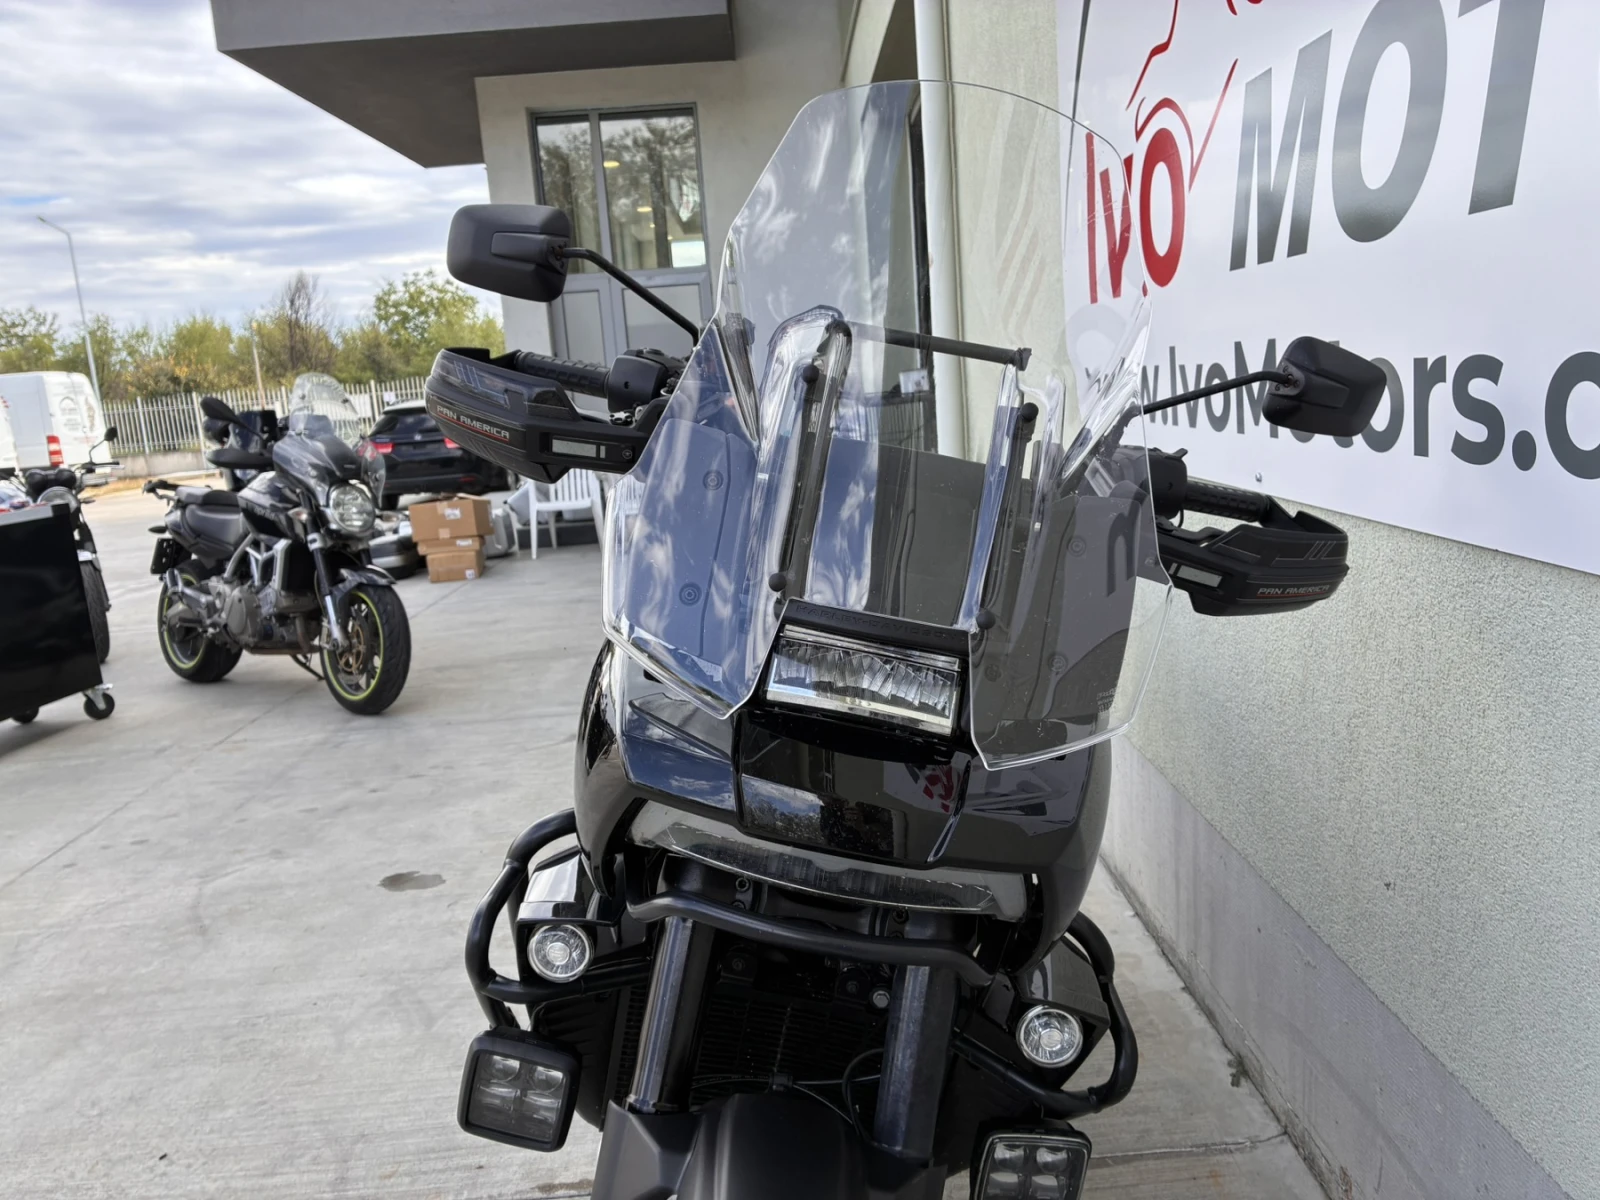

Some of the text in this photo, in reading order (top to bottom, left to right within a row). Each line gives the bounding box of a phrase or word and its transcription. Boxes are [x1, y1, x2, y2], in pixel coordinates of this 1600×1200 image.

[437, 405, 509, 439] PAN AMERICA
[1257, 585, 1330, 595] PAN AMERICA
